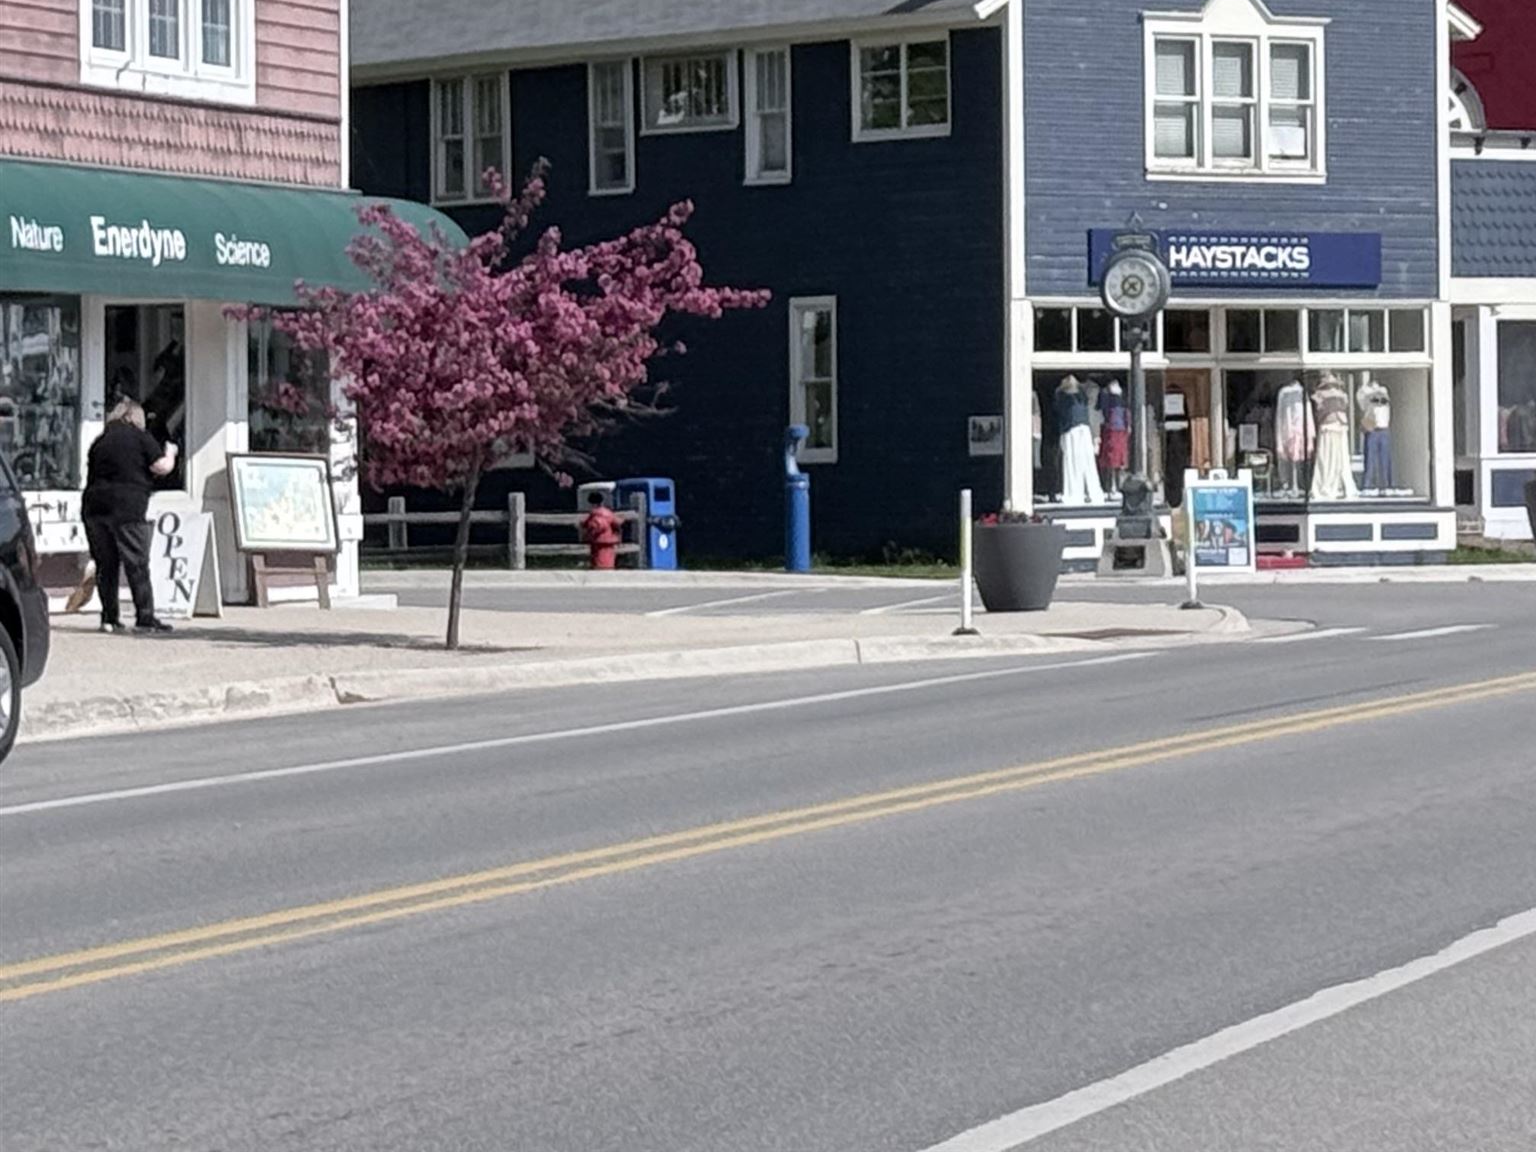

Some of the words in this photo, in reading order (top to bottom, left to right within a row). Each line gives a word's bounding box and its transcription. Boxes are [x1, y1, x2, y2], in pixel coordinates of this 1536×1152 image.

[10, 215, 64, 252] Nature
[90, 215, 187, 267] Enerdyne
[214, 232, 271, 267] Science
[1169, 245, 1310, 270] HAYSTACKS
[157, 511, 196, 603] OPEN
